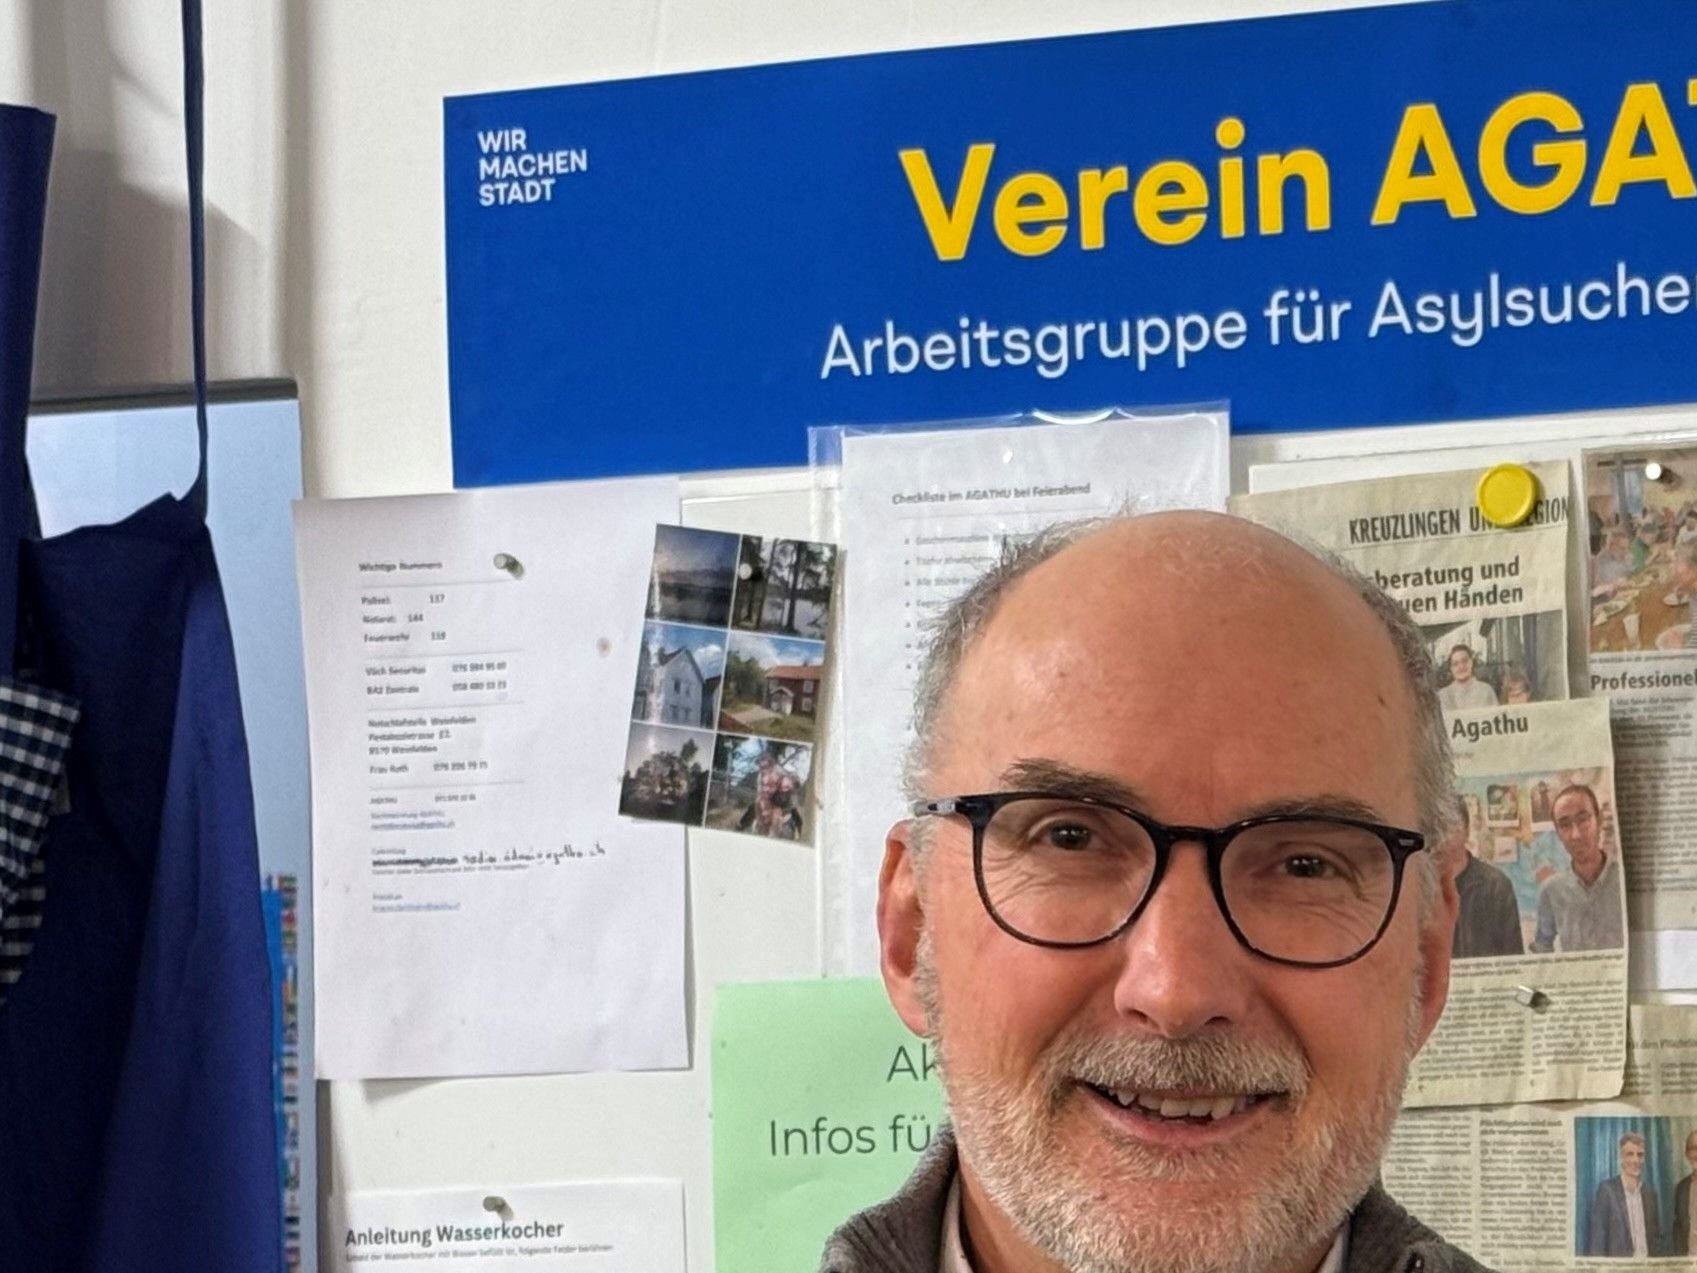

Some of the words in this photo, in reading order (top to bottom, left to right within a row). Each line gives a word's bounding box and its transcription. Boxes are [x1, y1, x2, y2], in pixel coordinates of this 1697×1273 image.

[478, 128, 527, 153] WIR
[479, 149, 587, 181] MACHEN
[479, 180, 555, 206] STADT
[899, 118, 1331, 262] Verein
[820, 305, 1247, 379] Arbeitsgruppe
[1264, 290, 1351, 346] für
[1349, 508, 1461, 544] KREUZLINGEN
[1368, 564, 1473, 590] beratung
[1480, 554, 1520, 580] und
[1444, 583, 1523, 610] Händen
[1451, 712, 1529, 742] Agathu
[887, 1043, 937, 1082] Ak
[770, 1116, 876, 1157] Infos
[889, 1114, 931, 1153] fü
[345, 1226, 432, 1248] Anleitung
[436, 1221, 564, 1243] Wasserkocher
